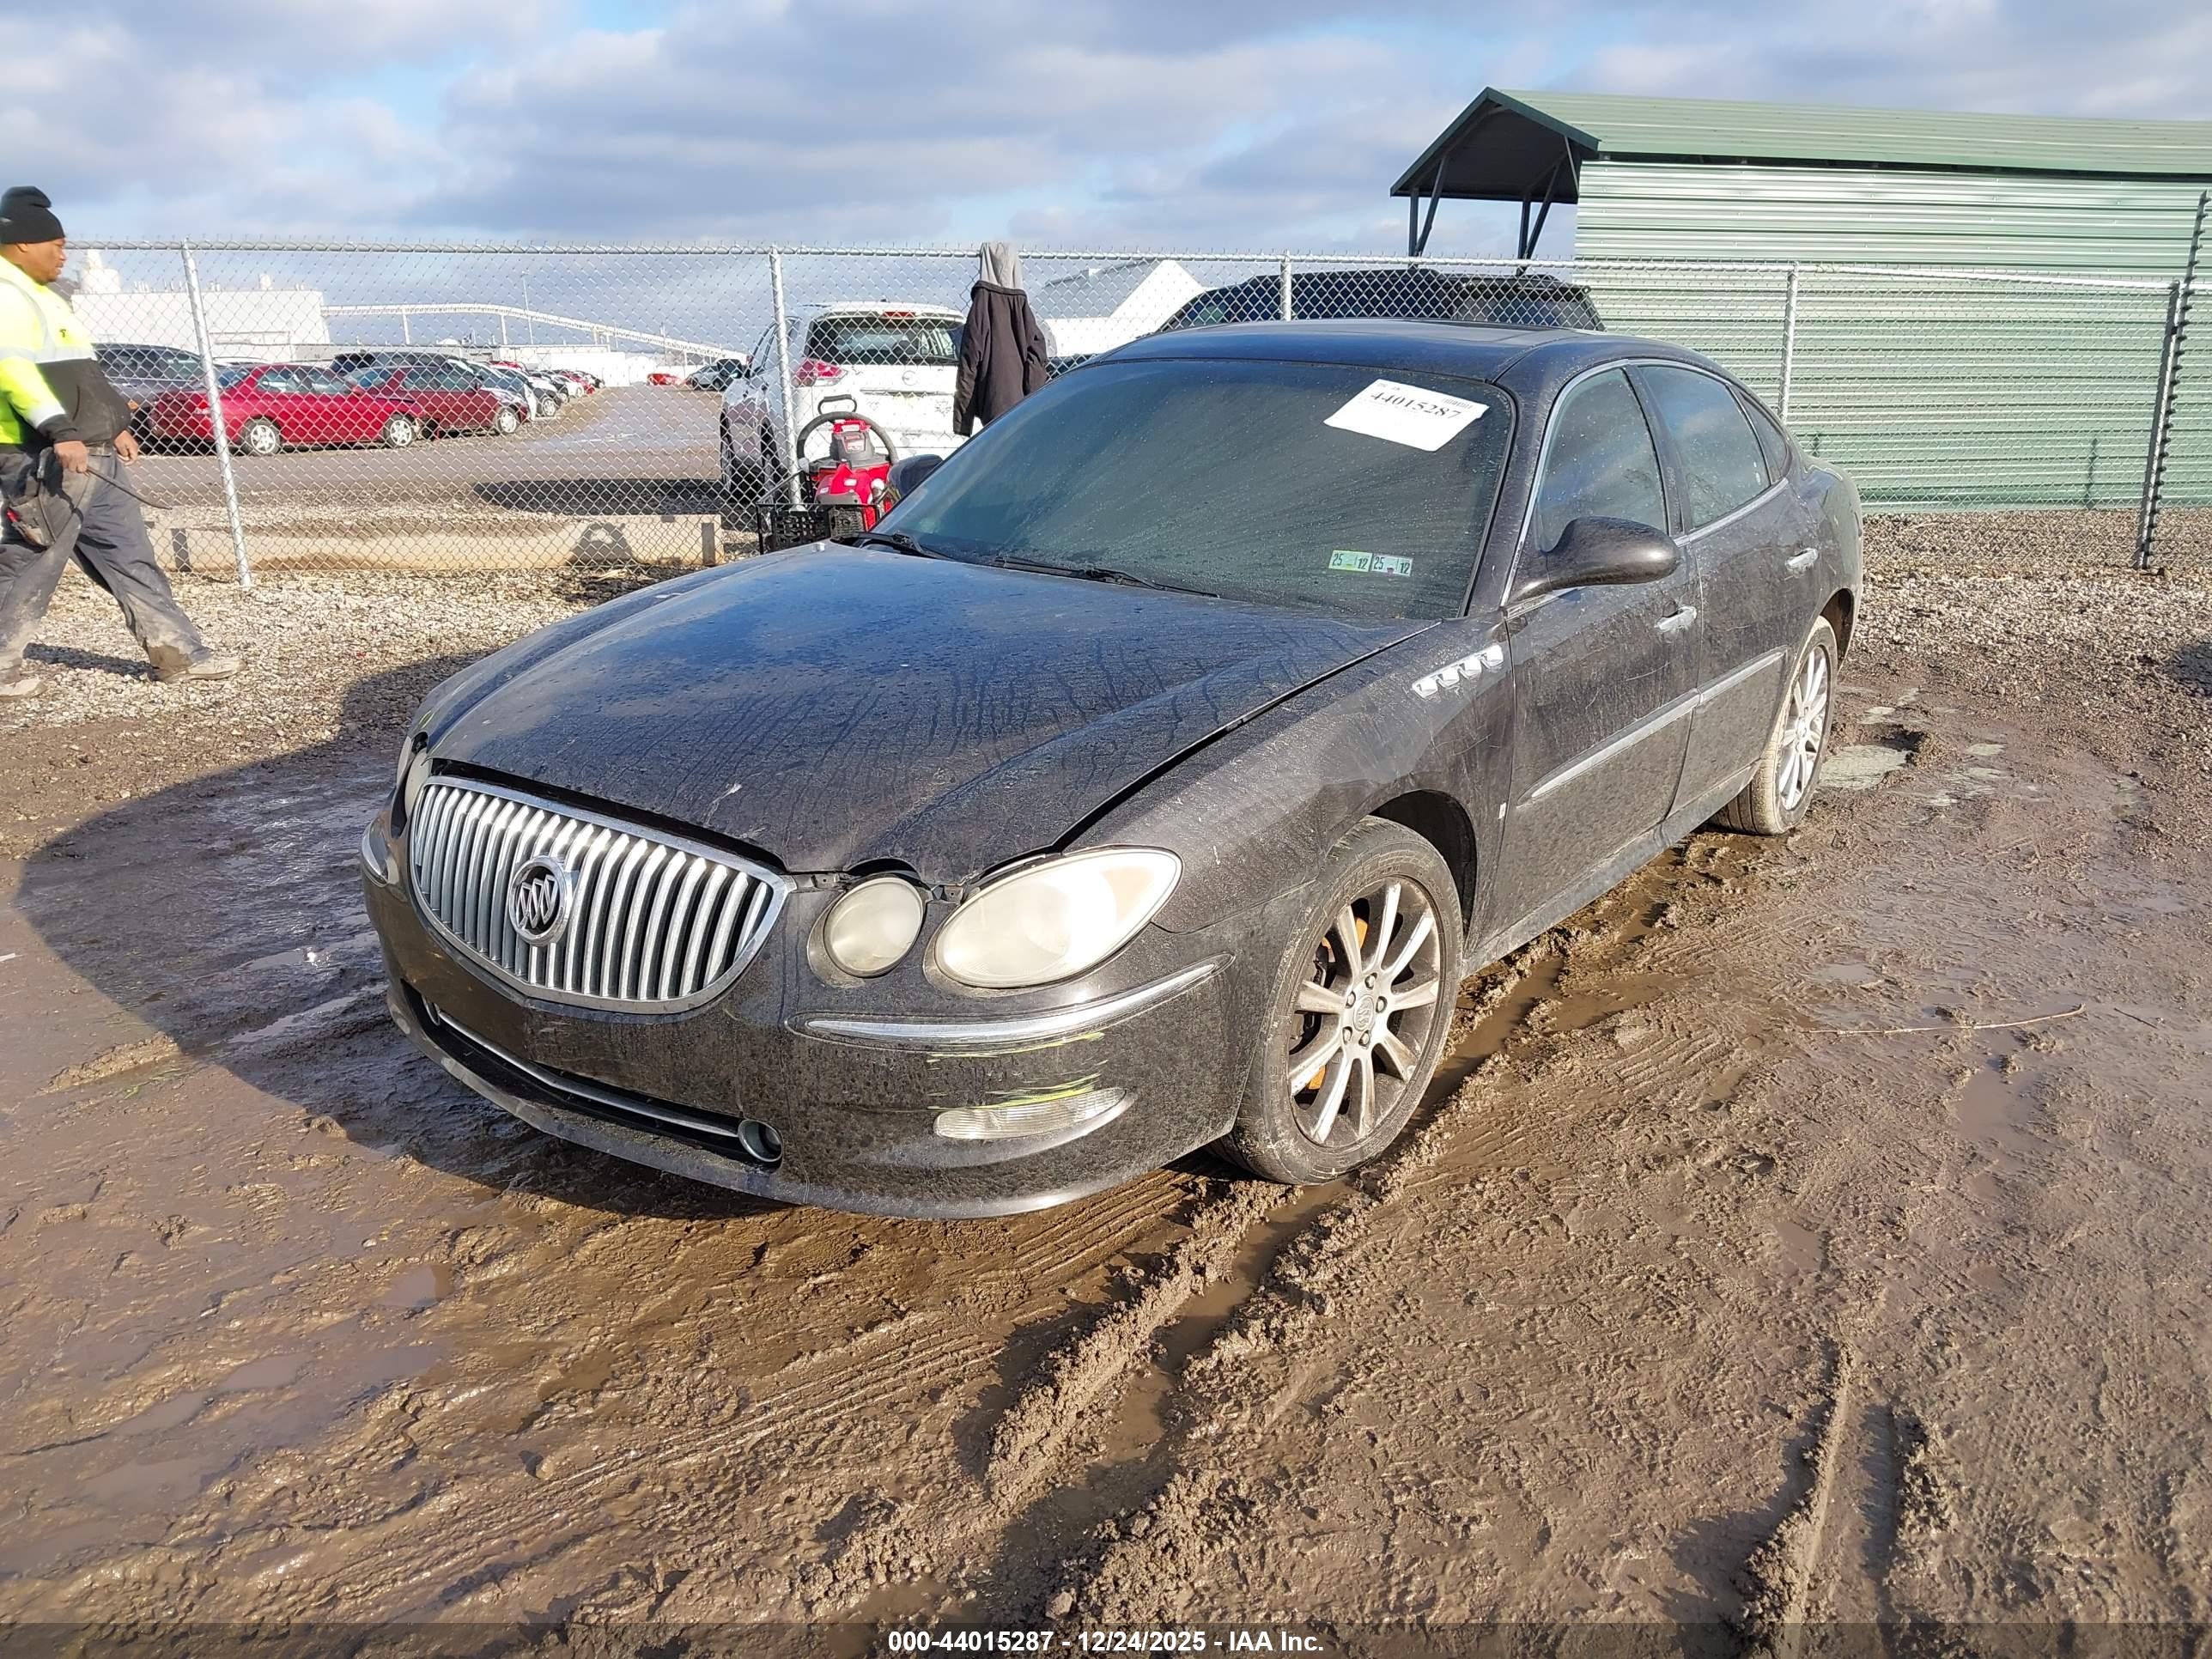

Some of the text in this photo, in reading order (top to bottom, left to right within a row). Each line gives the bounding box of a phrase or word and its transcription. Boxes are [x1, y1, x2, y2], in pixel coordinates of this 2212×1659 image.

[1370, 392, 1462, 419] 44015287
[1332, 553, 1369, 570] 25 12
[1374, 556, 1411, 574] 25 12
